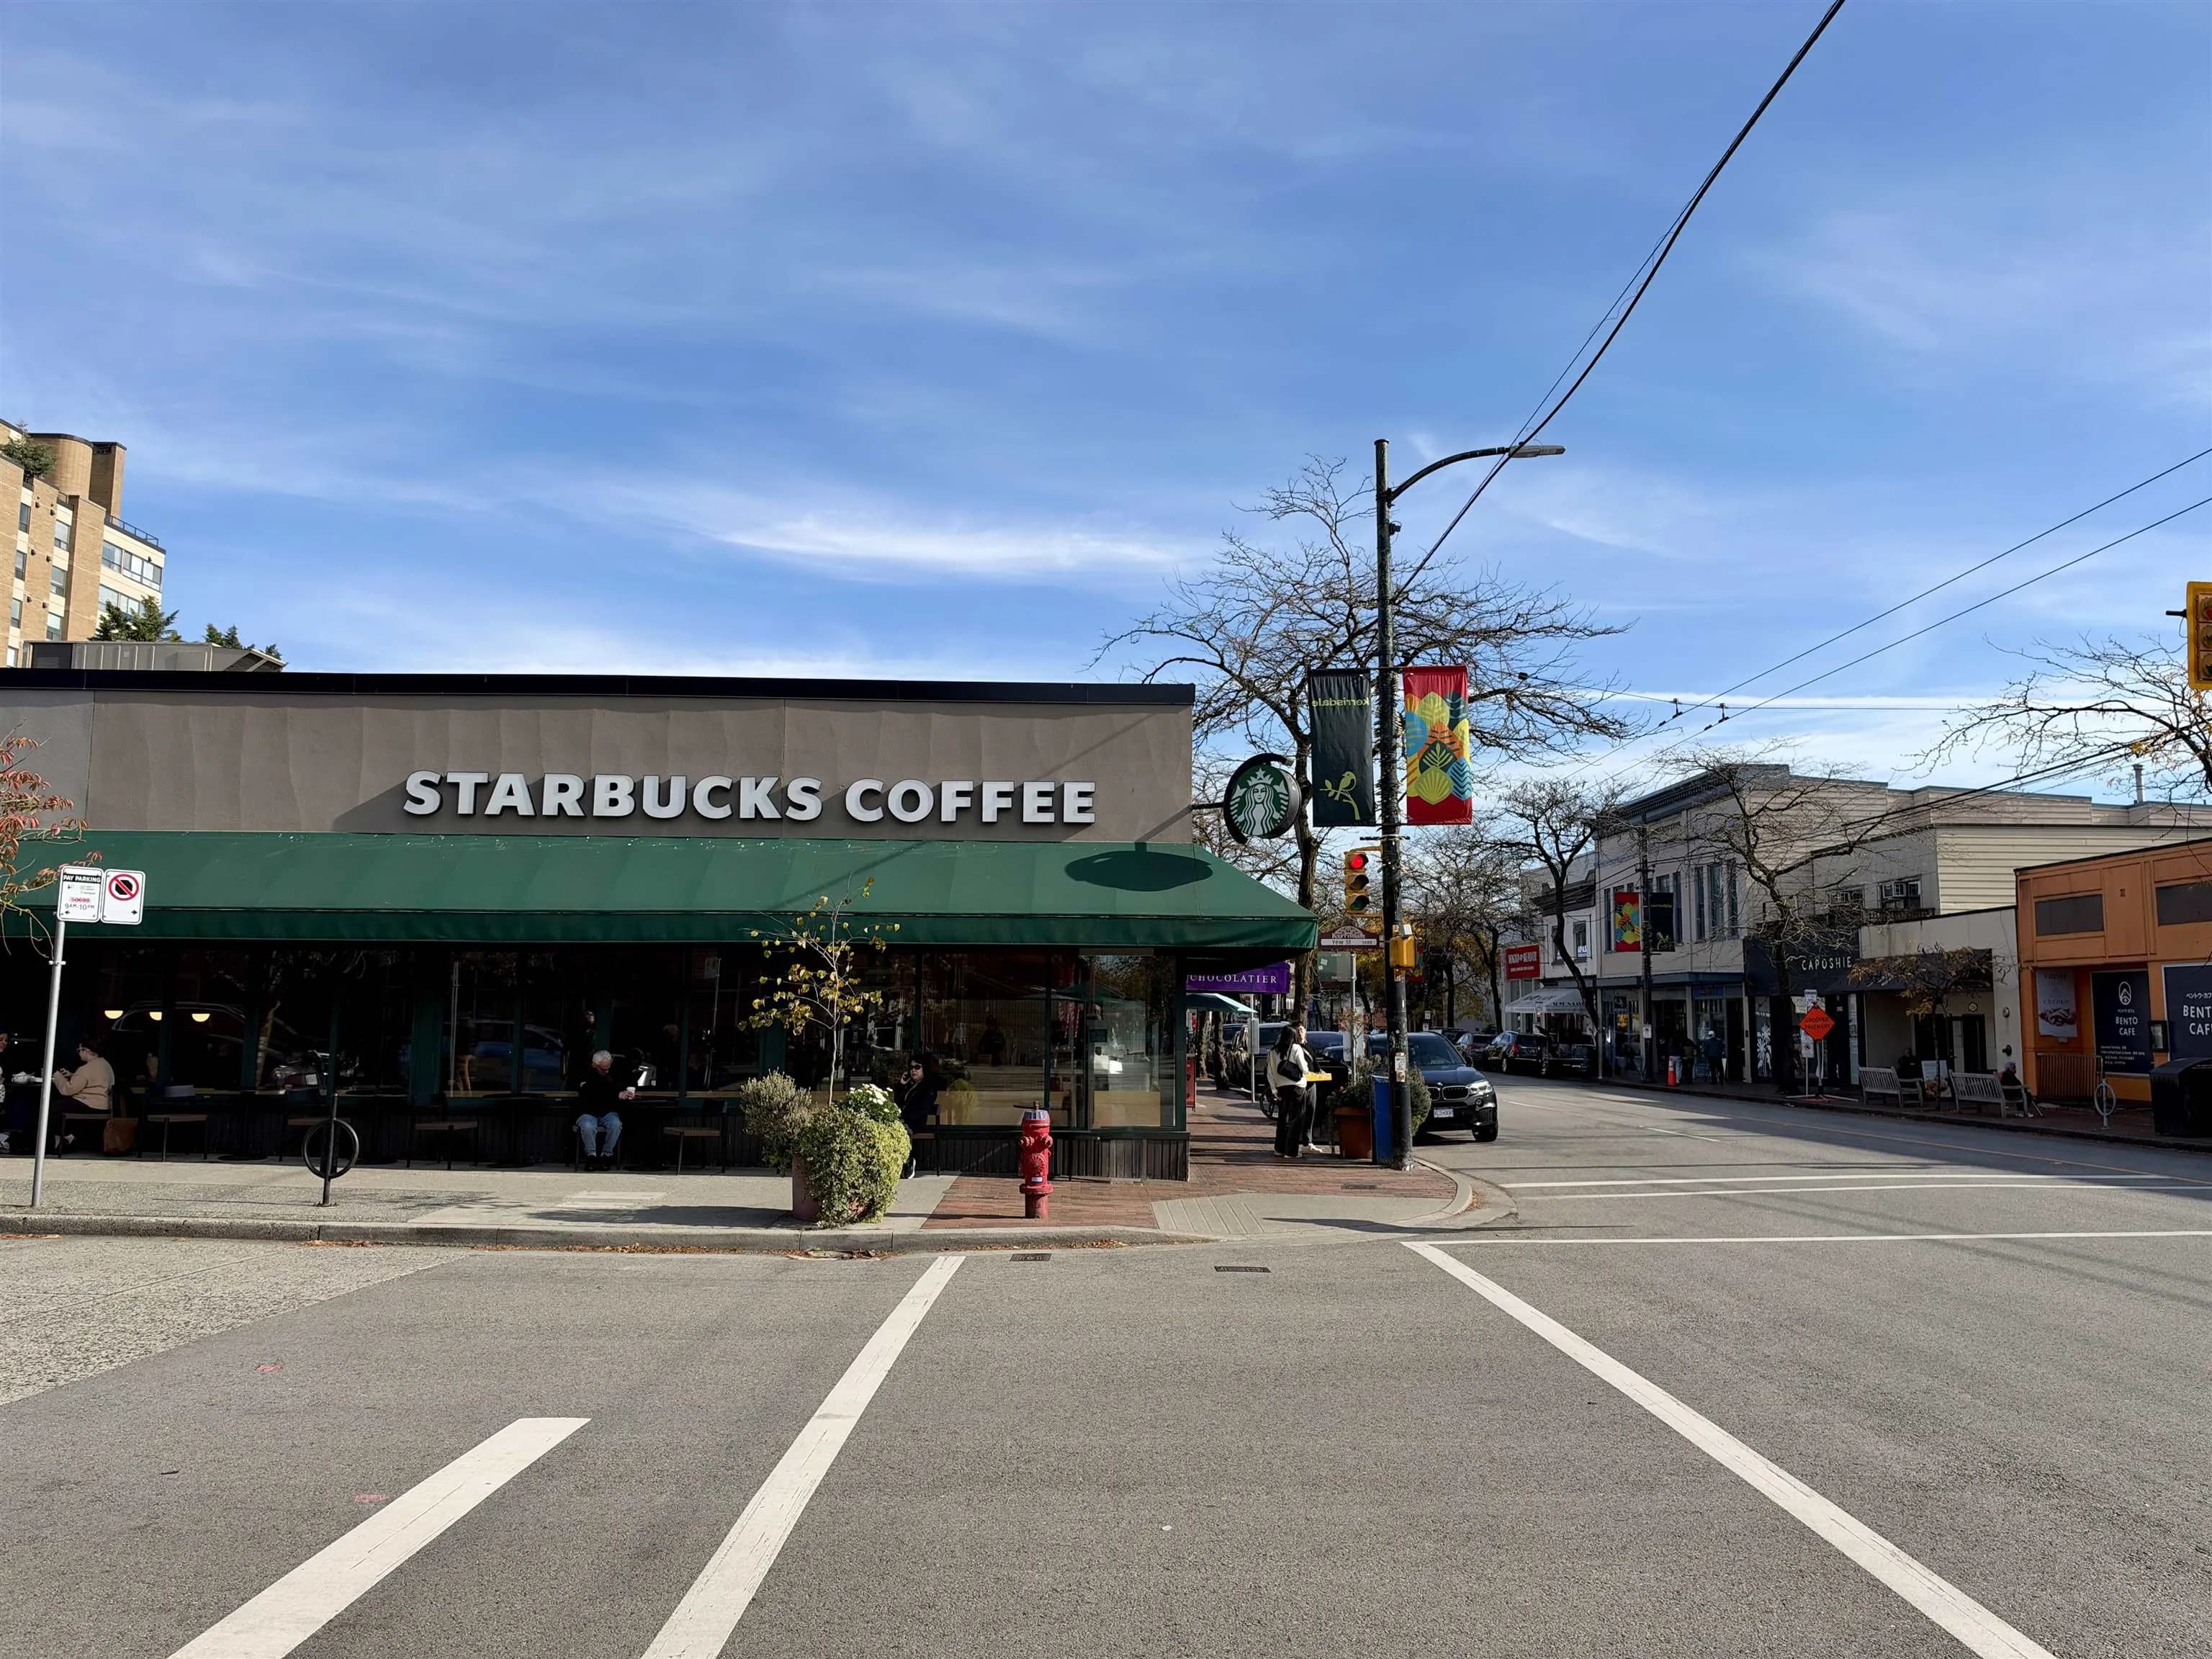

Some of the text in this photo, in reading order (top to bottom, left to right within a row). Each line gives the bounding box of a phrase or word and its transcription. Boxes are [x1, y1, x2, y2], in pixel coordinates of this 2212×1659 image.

[403, 770, 1096, 824] STARBUCKS COFFEE
[1802, 956, 1852, 971] CAPOSHIE
[1190, 974, 1277, 984] CHOCOLATIER
[2115, 1016, 2139, 1025] BENTO
[2119, 1028, 2136, 1036] CAFE
[2189, 1022, 2212, 1036] CAF
